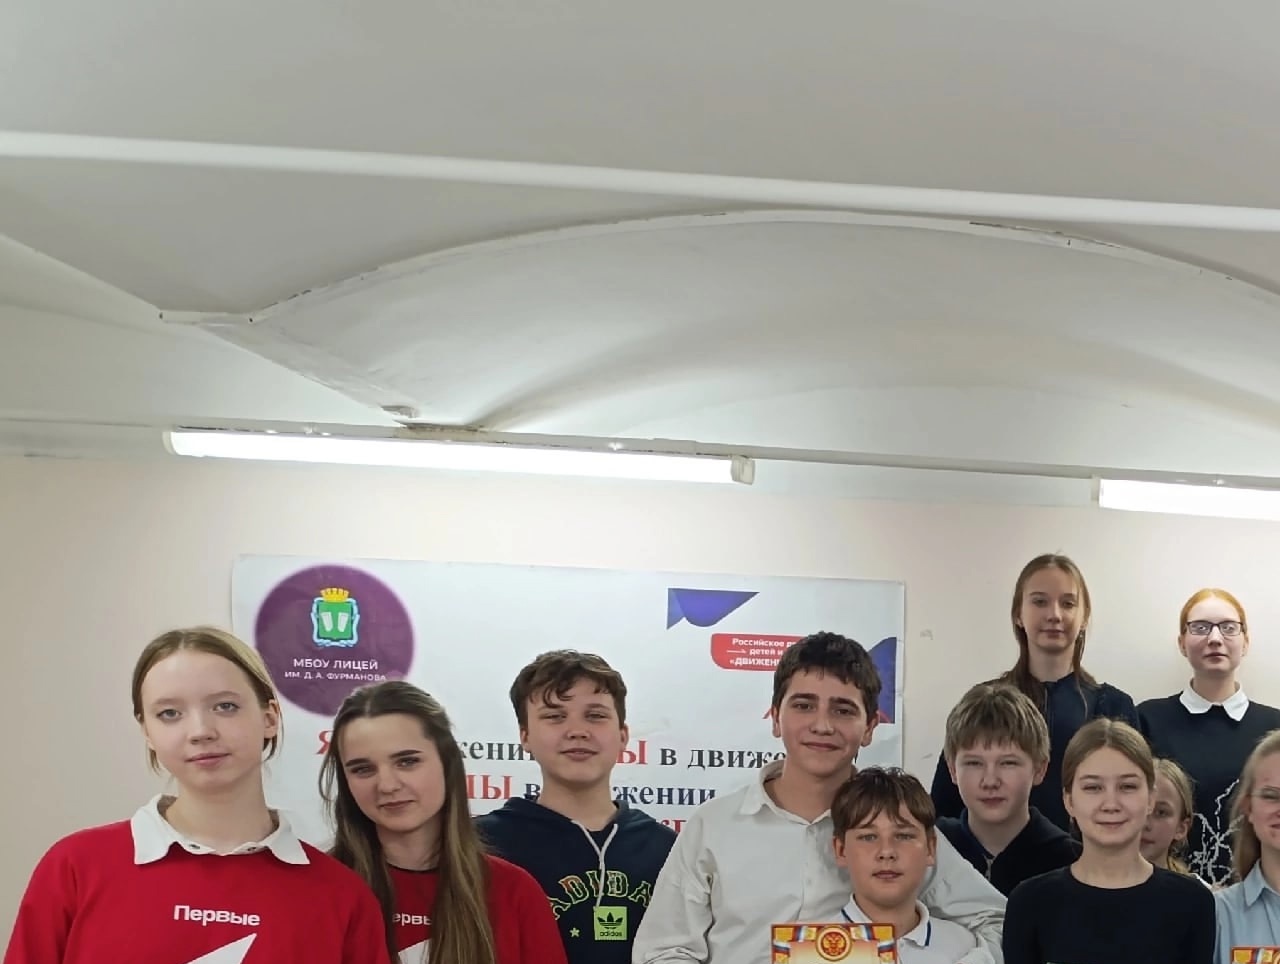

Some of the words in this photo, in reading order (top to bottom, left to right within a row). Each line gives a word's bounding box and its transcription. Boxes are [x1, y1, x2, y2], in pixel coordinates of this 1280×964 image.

[732, 637, 785, 648] Российское
[293, 658, 330, 669] МБОУ
[333, 658, 379, 671] ЛИЦЕЙ
[730, 657, 780, 667] «ДВИЖЕН
[326, 673, 386, 682] ФУРМАНОВА
[660, 748, 677, 766] в
[547, 869, 652, 920] ADIDA
[174, 904, 260, 926] Первые
